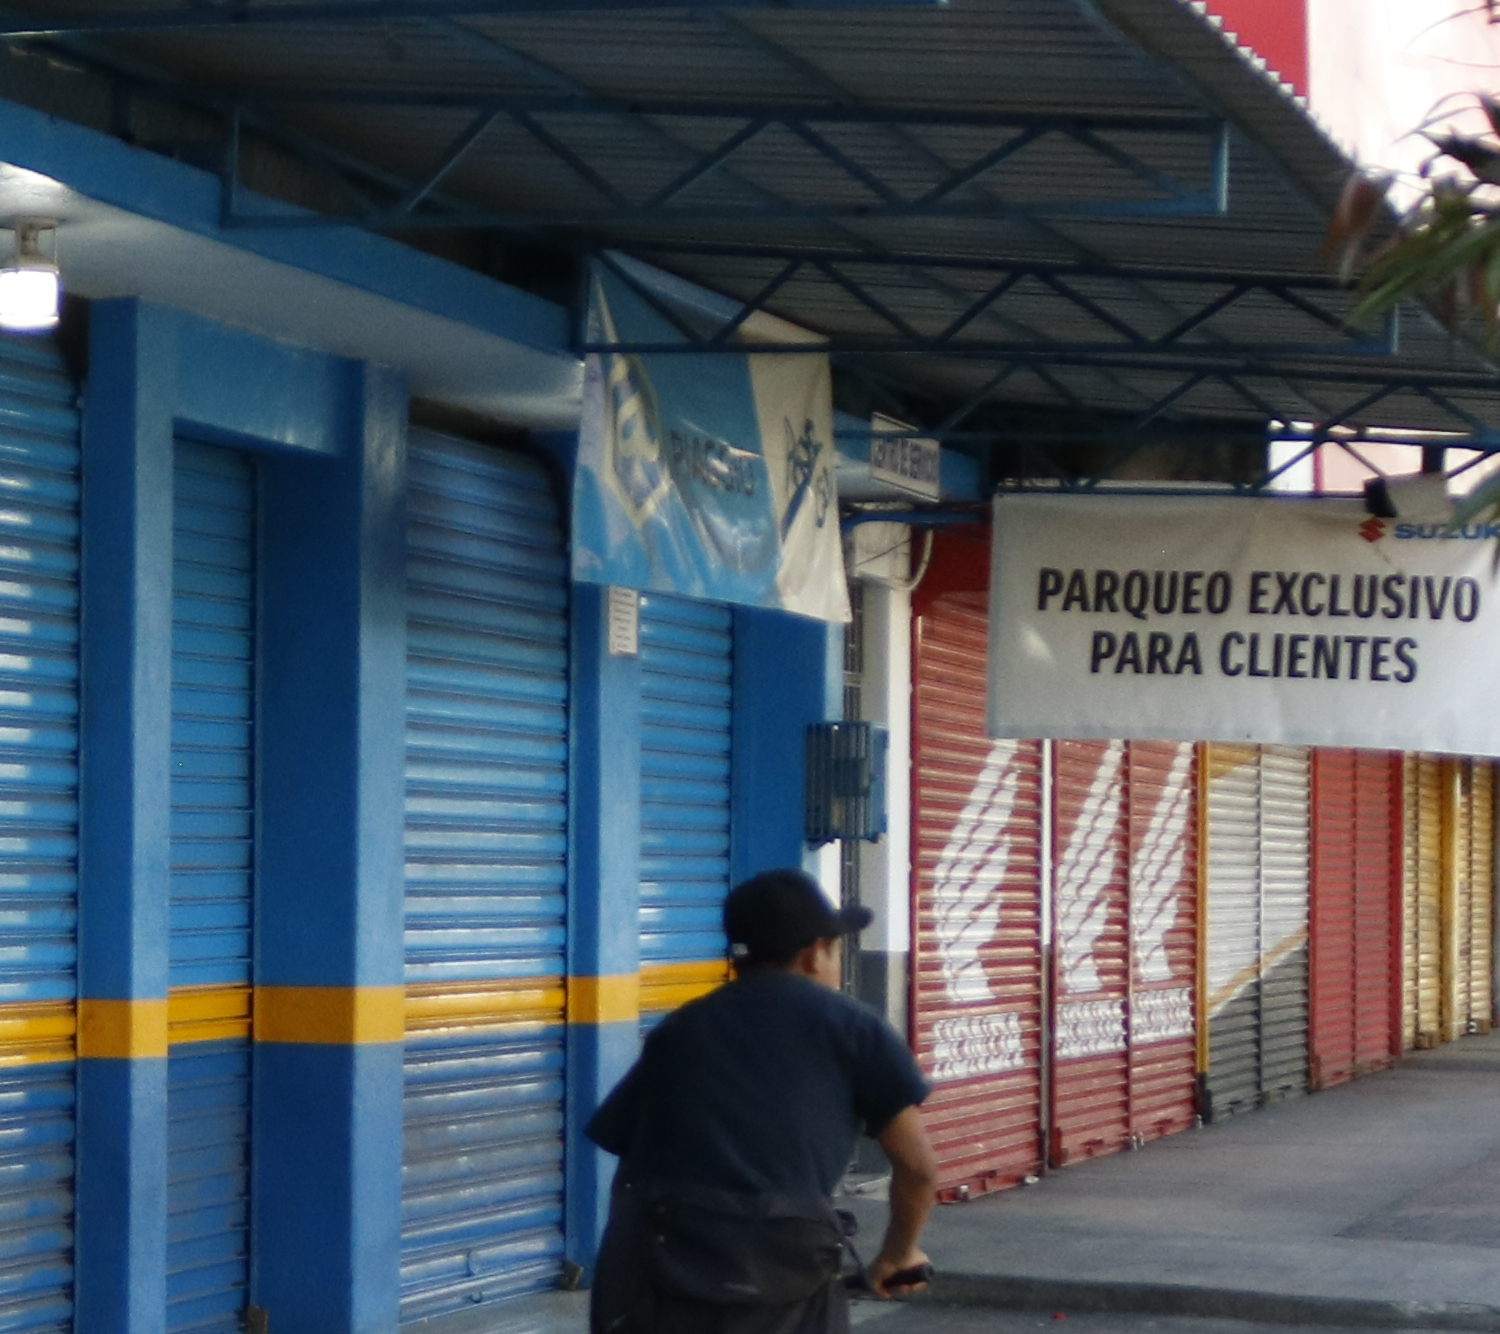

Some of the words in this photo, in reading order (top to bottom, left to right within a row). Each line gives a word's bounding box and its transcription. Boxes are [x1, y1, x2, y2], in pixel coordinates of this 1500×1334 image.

[1037, 568, 1232, 620] PARQUEO
[1248, 570, 1479, 623] EXCLUSIVO
[1089, 631, 1203, 676] PARA
[1219, 631, 1418, 683] CLIENTES
